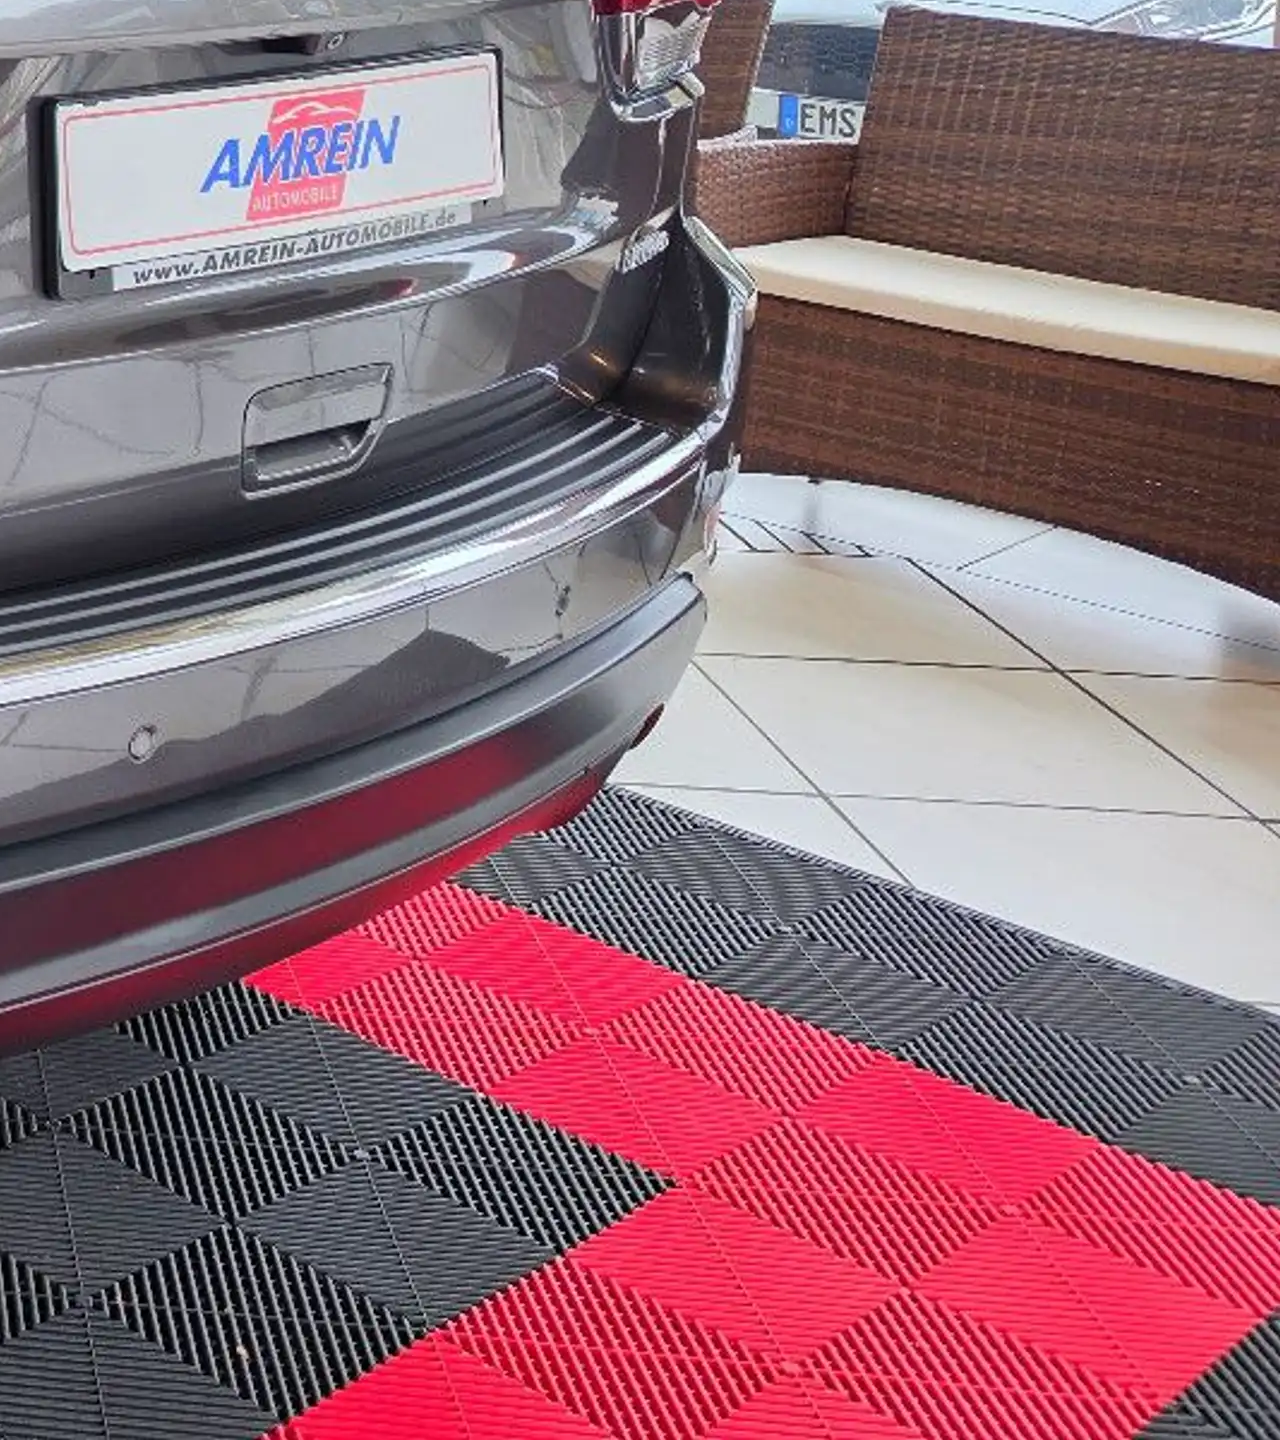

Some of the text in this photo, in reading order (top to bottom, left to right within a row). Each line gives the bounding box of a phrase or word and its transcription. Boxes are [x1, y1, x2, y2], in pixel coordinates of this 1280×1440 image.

[800, 103, 856, 138] EMS
[199, 115, 401, 193] AMREIN
[252, 184, 339, 212] AUTOMOBILE
[132, 208, 457, 285] www.AMREIN-AUTOMOBILE.de
